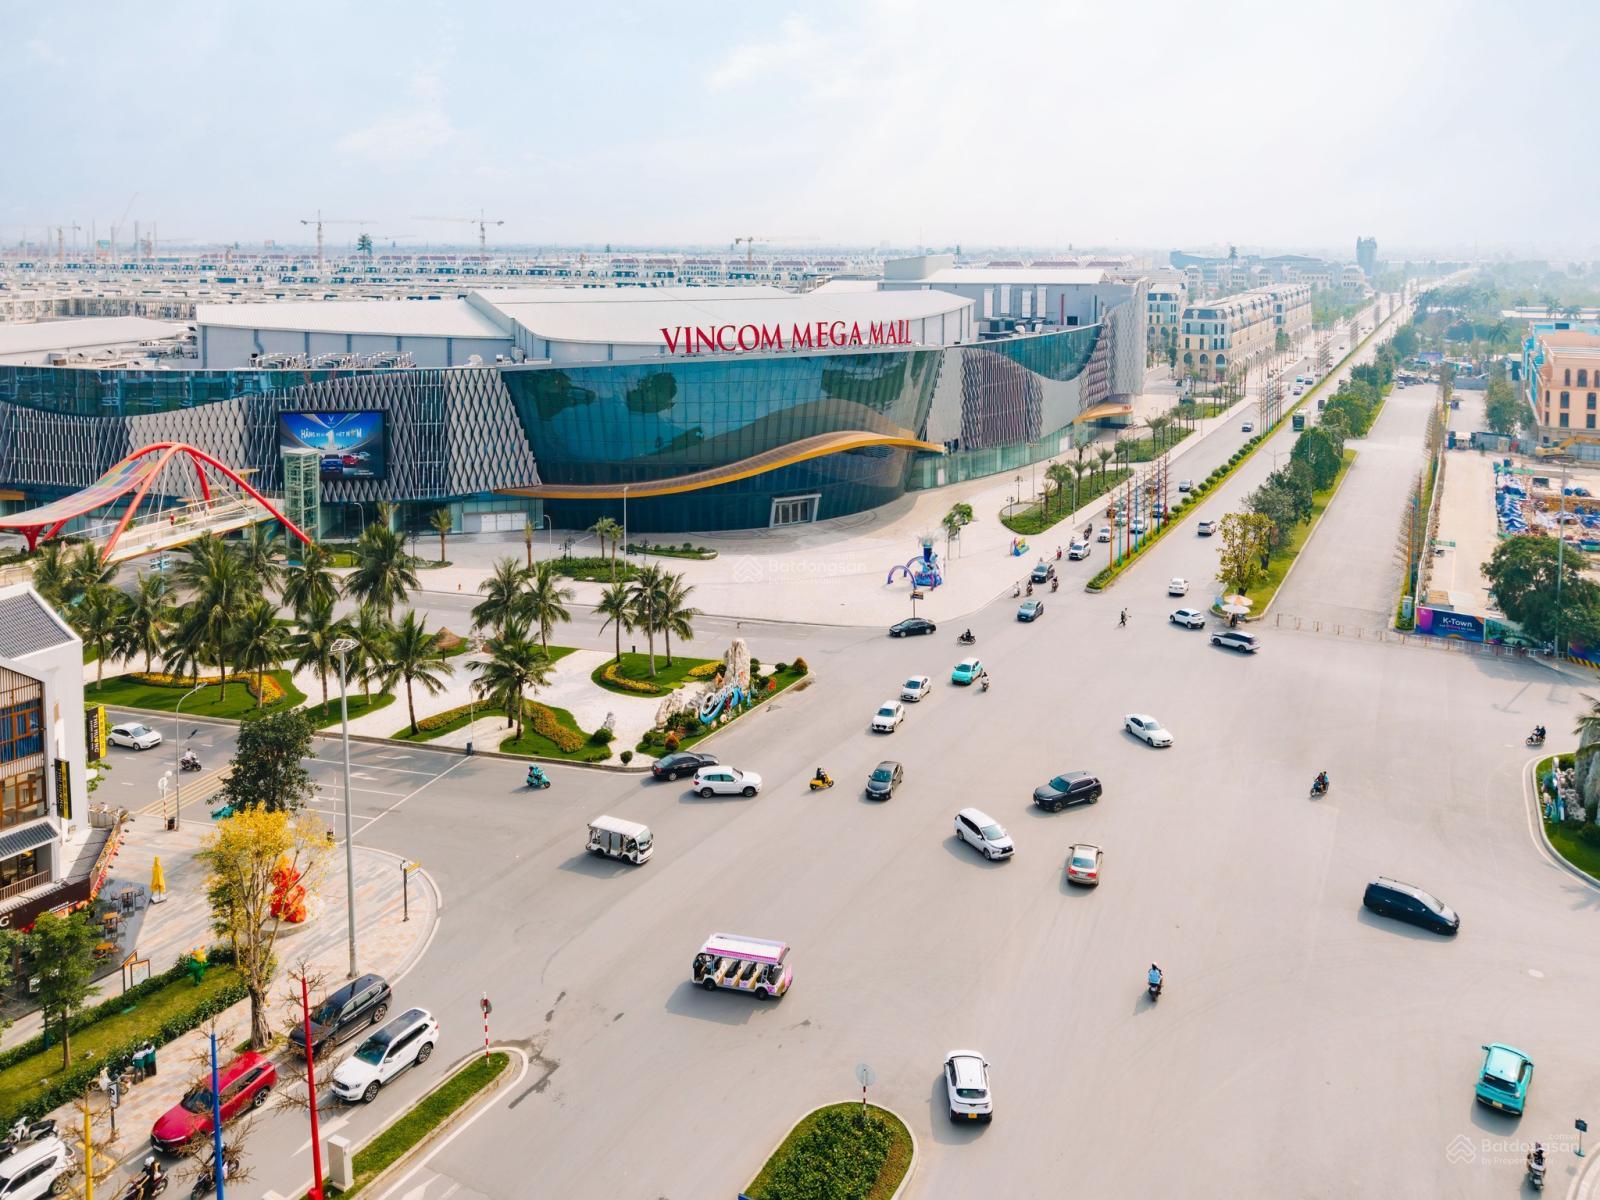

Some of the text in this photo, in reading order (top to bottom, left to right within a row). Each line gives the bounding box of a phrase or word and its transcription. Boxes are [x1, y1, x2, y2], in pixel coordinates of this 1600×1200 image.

[660, 319, 912, 354] VINCOM MEGA MALL
[1442, 617, 1473, 628] K-Town
